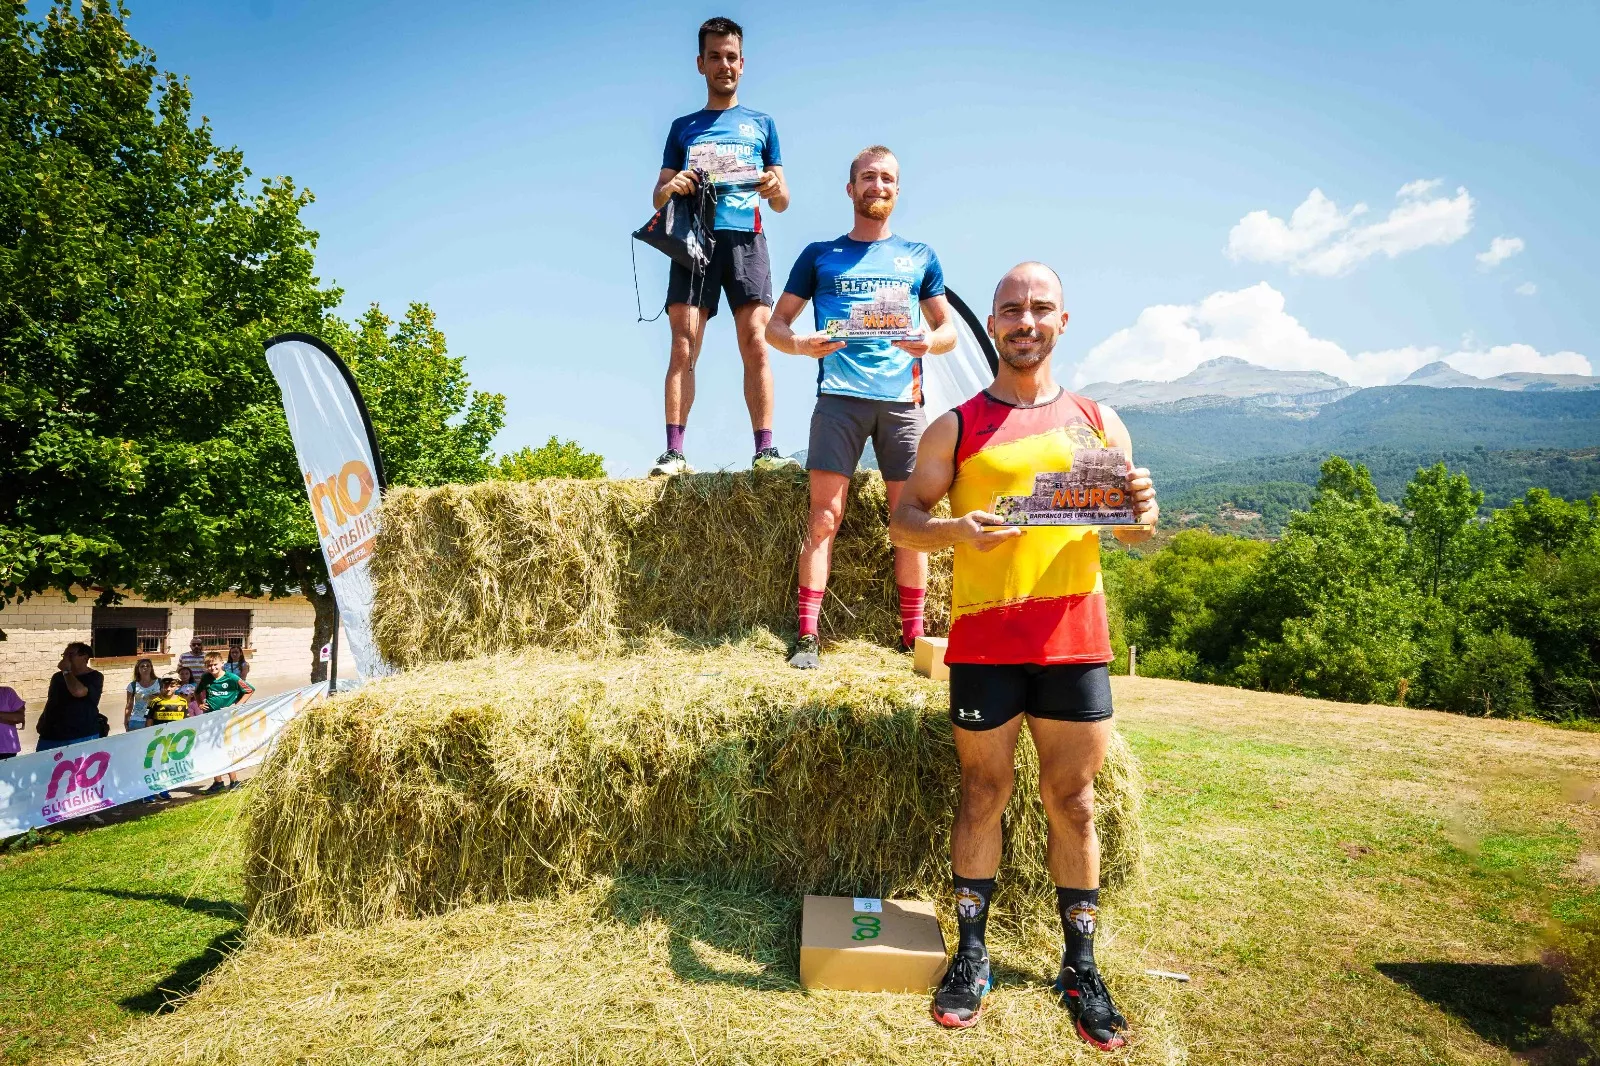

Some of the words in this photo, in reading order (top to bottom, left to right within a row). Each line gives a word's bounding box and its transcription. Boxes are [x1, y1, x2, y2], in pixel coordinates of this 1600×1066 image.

[841, 281, 859, 293] EL
[863, 312, 909, 328] MURO
[1051, 487, 1125, 508] MURO
